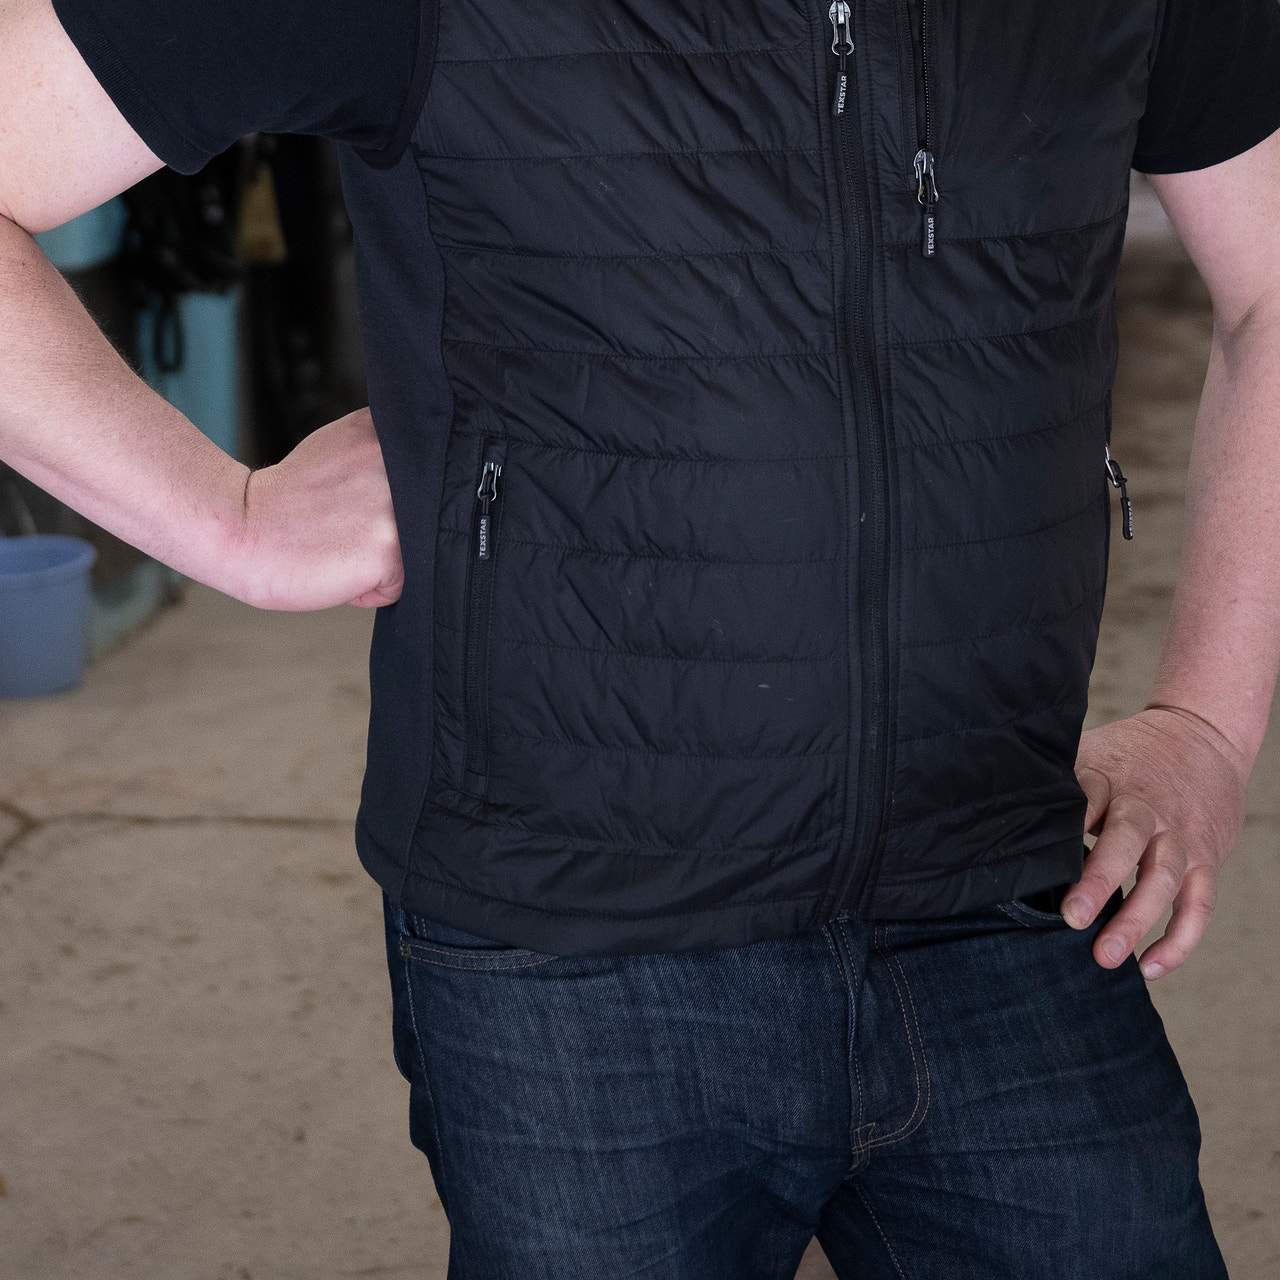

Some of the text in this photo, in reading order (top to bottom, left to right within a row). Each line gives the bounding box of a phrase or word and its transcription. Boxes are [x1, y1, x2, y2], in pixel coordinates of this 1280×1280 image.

[837, 75, 847, 114] TEXSTAR
[927, 217, 935, 255] TEXSTAR
[479, 518, 487, 557] TEXSTAR
